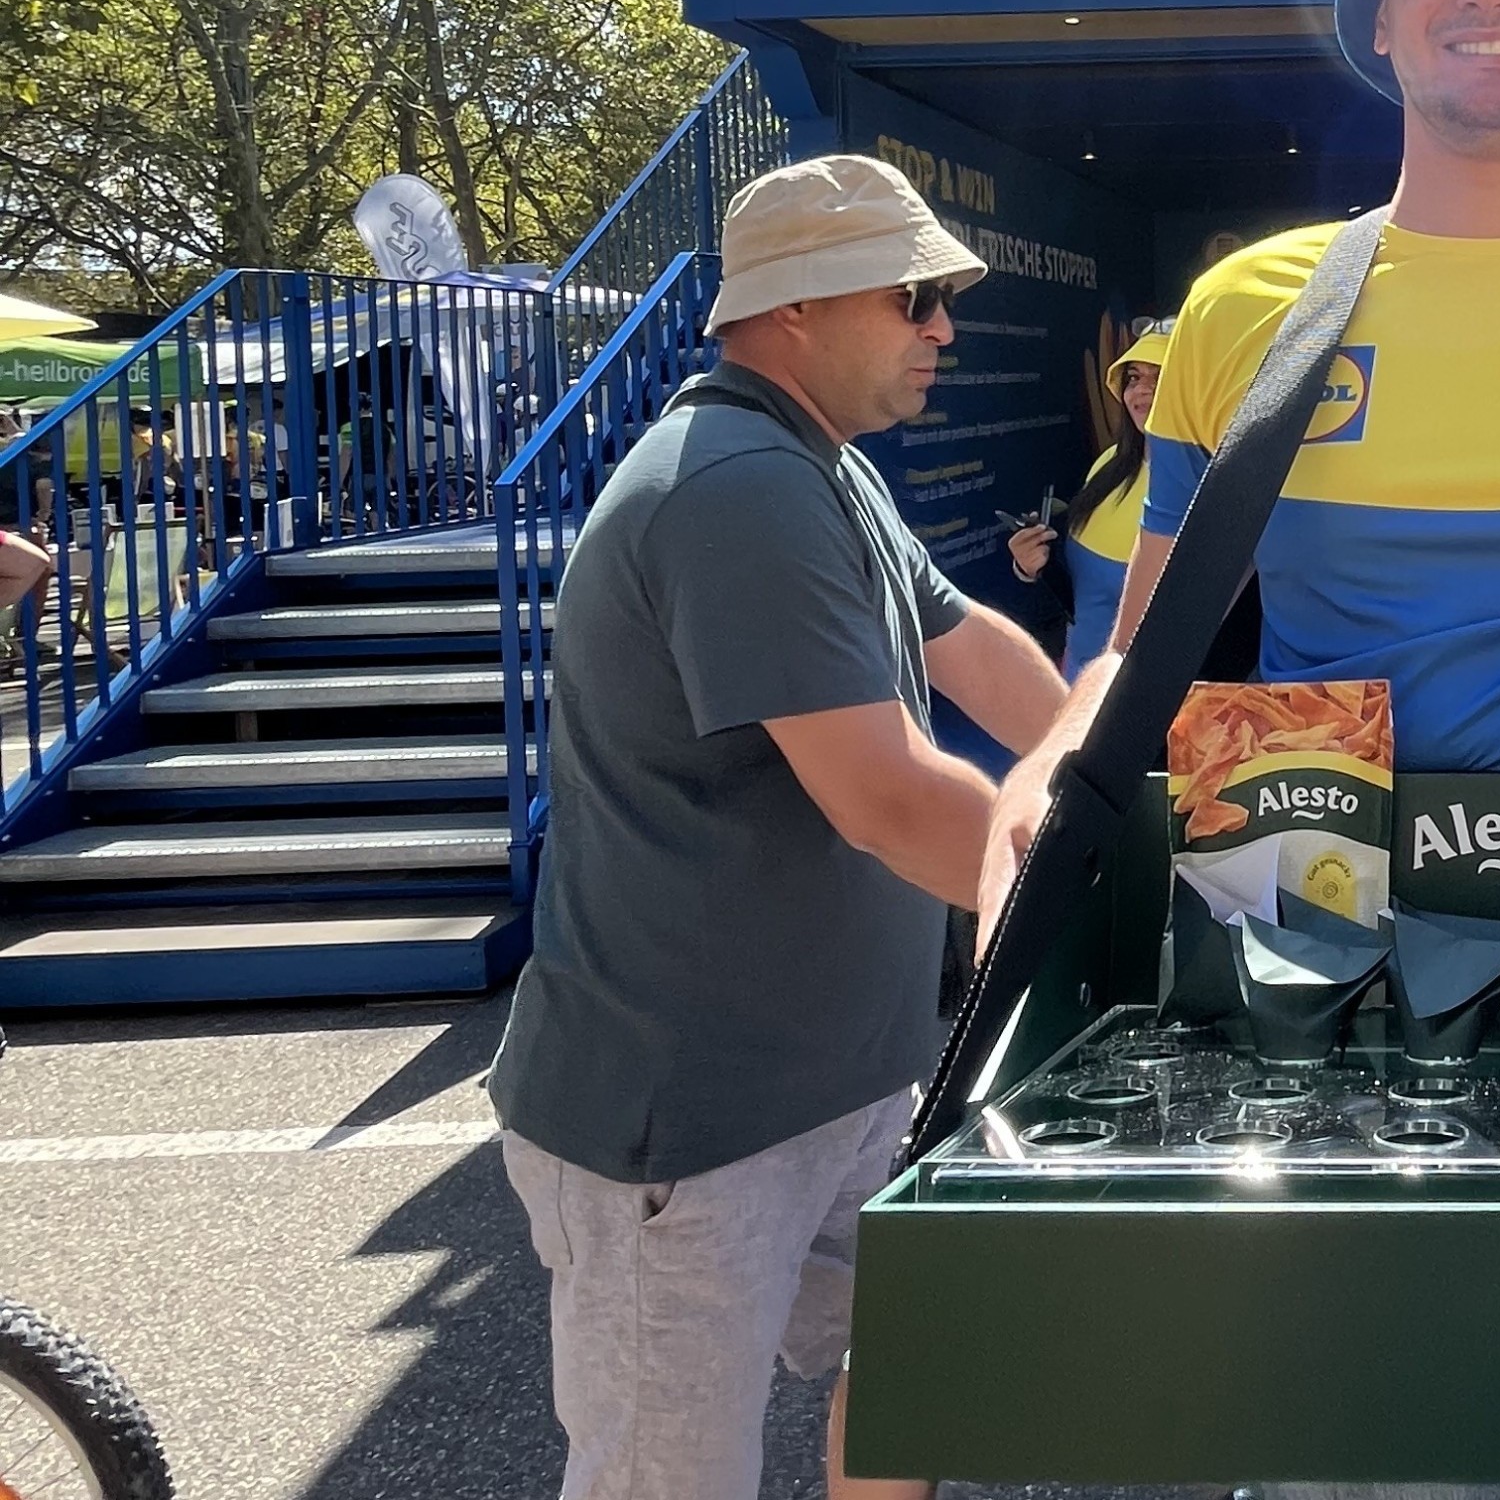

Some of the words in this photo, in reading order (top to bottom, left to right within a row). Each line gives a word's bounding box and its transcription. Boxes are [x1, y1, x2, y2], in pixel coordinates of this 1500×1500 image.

[956, 162, 996, 216] WIN
[978, 227, 1043, 281] FRISCHE
[1044, 244, 1098, 290] STOPPER
[1258, 781, 1359, 817] Alesto
